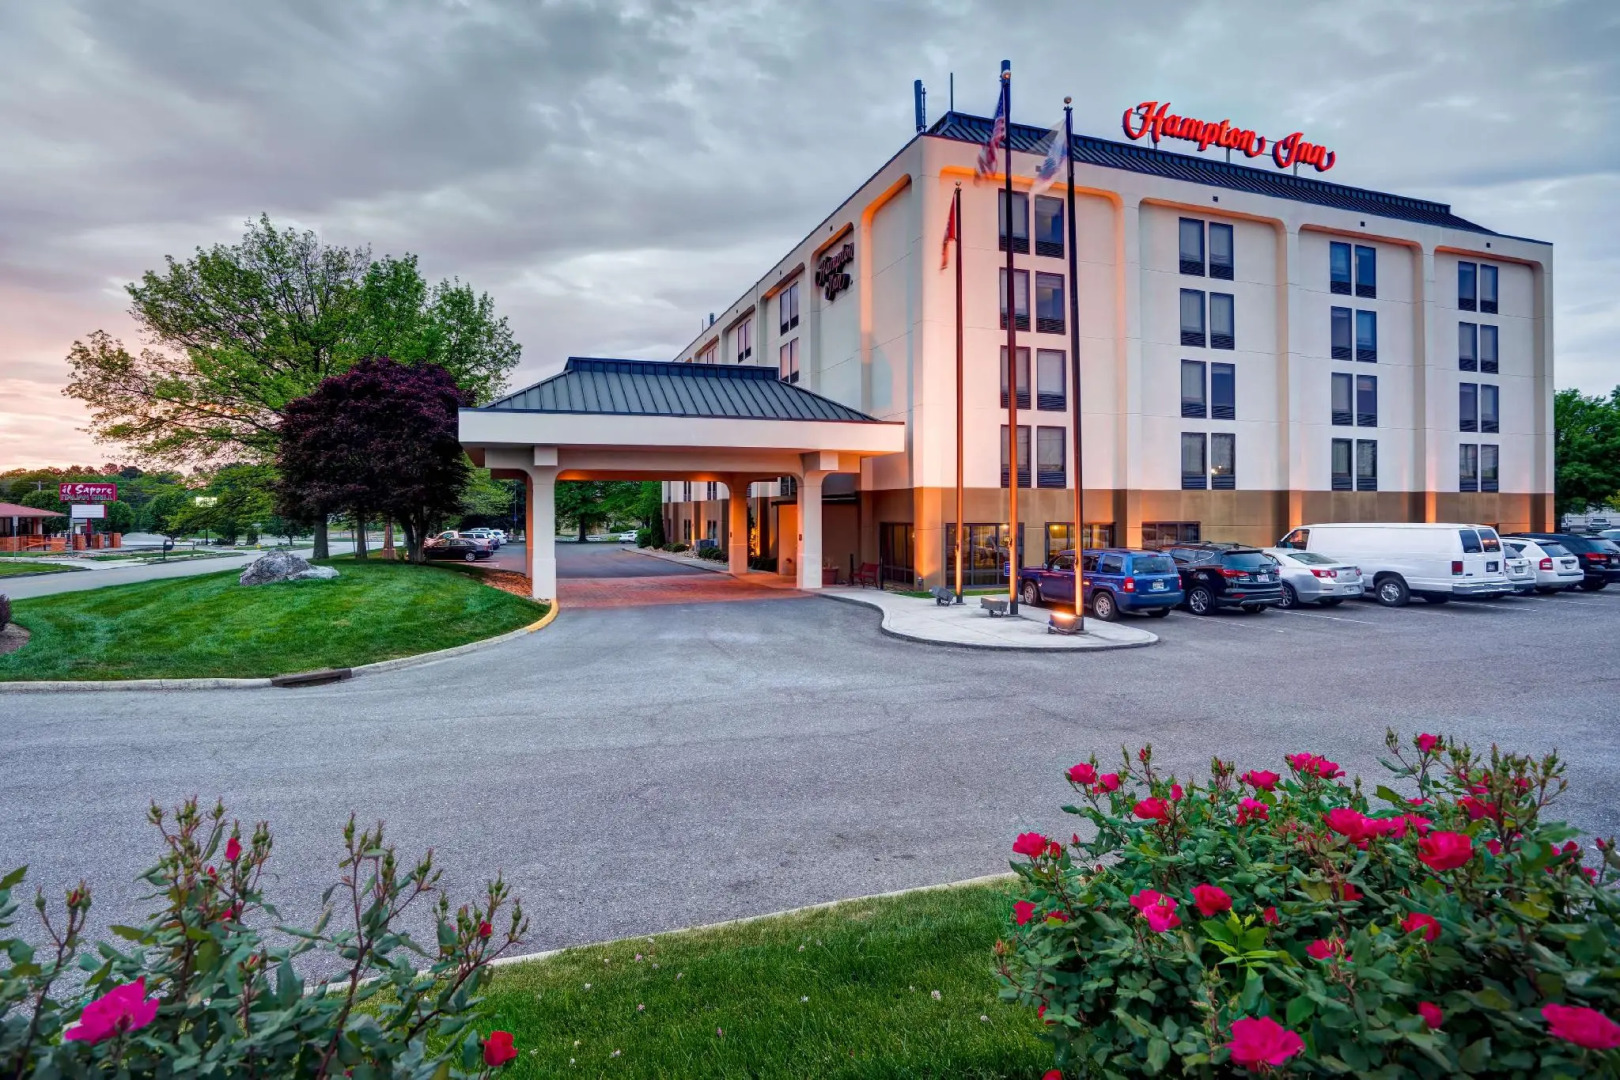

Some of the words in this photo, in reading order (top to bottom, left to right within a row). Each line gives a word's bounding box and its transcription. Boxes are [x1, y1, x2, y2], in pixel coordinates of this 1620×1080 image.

[1122, 101, 1266, 157] Hampton
[1272, 132, 1336, 172] Inn
[75, 484, 112, 496] Sapore
